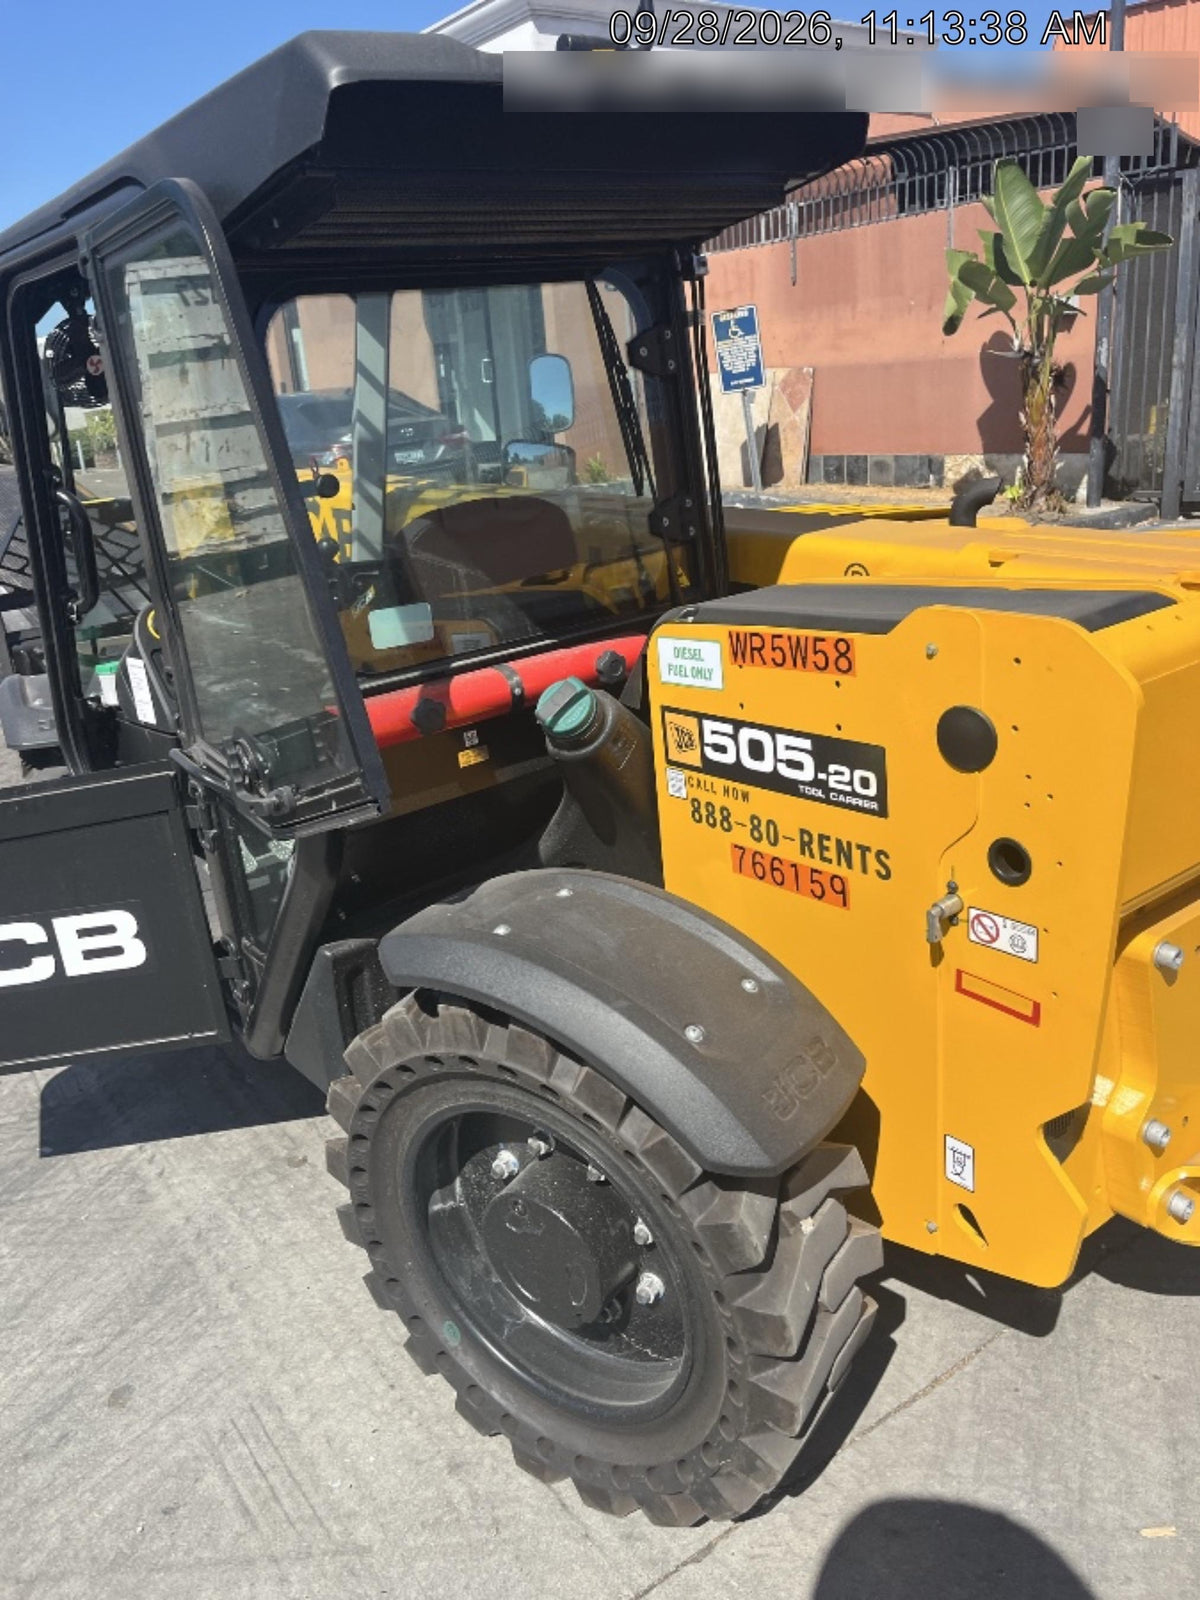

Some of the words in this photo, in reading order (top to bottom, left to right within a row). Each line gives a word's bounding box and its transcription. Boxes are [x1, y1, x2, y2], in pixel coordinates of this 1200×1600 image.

[673, 646, 704, 662] DIESEL
[729, 630, 852, 674] WR5W58
[668, 663, 689, 678] FUEL
[691, 666, 714, 681] ONLY
[702, 718, 877, 797] 505-20
[688, 775, 717, 794] CALL
[723, 785, 750, 803] NOW
[798, 784, 825, 800] TOOL
[829, 792, 879, 811] CARRIER
[690, 797, 892, 881] 888-80-RENTS
[734, 844, 847, 908] 766159
